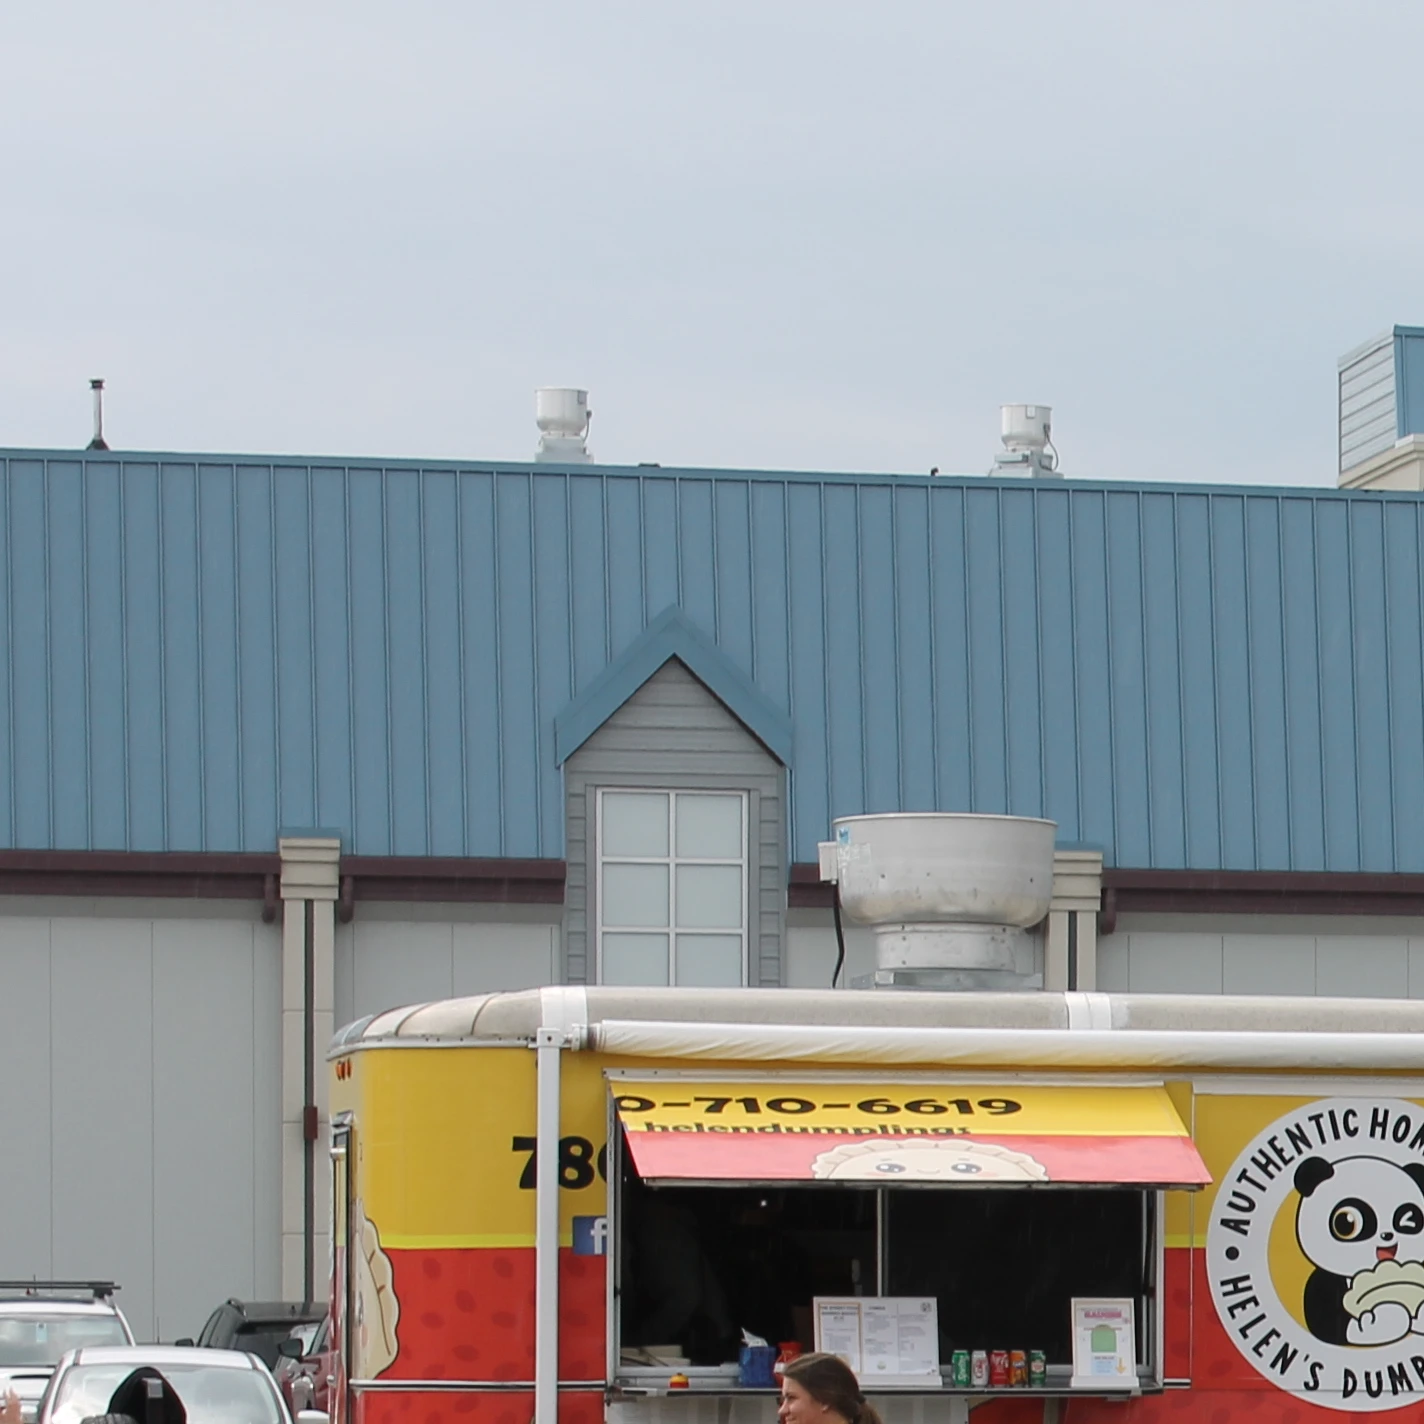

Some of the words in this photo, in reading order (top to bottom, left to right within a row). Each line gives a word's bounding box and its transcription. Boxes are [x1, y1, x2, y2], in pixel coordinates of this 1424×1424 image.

[512, 1135, 607, 1189] 78
[1219, 1108, 1359, 1236] AUTHENTIC
[1219, 1274, 1324, 1392] HELEN'S
